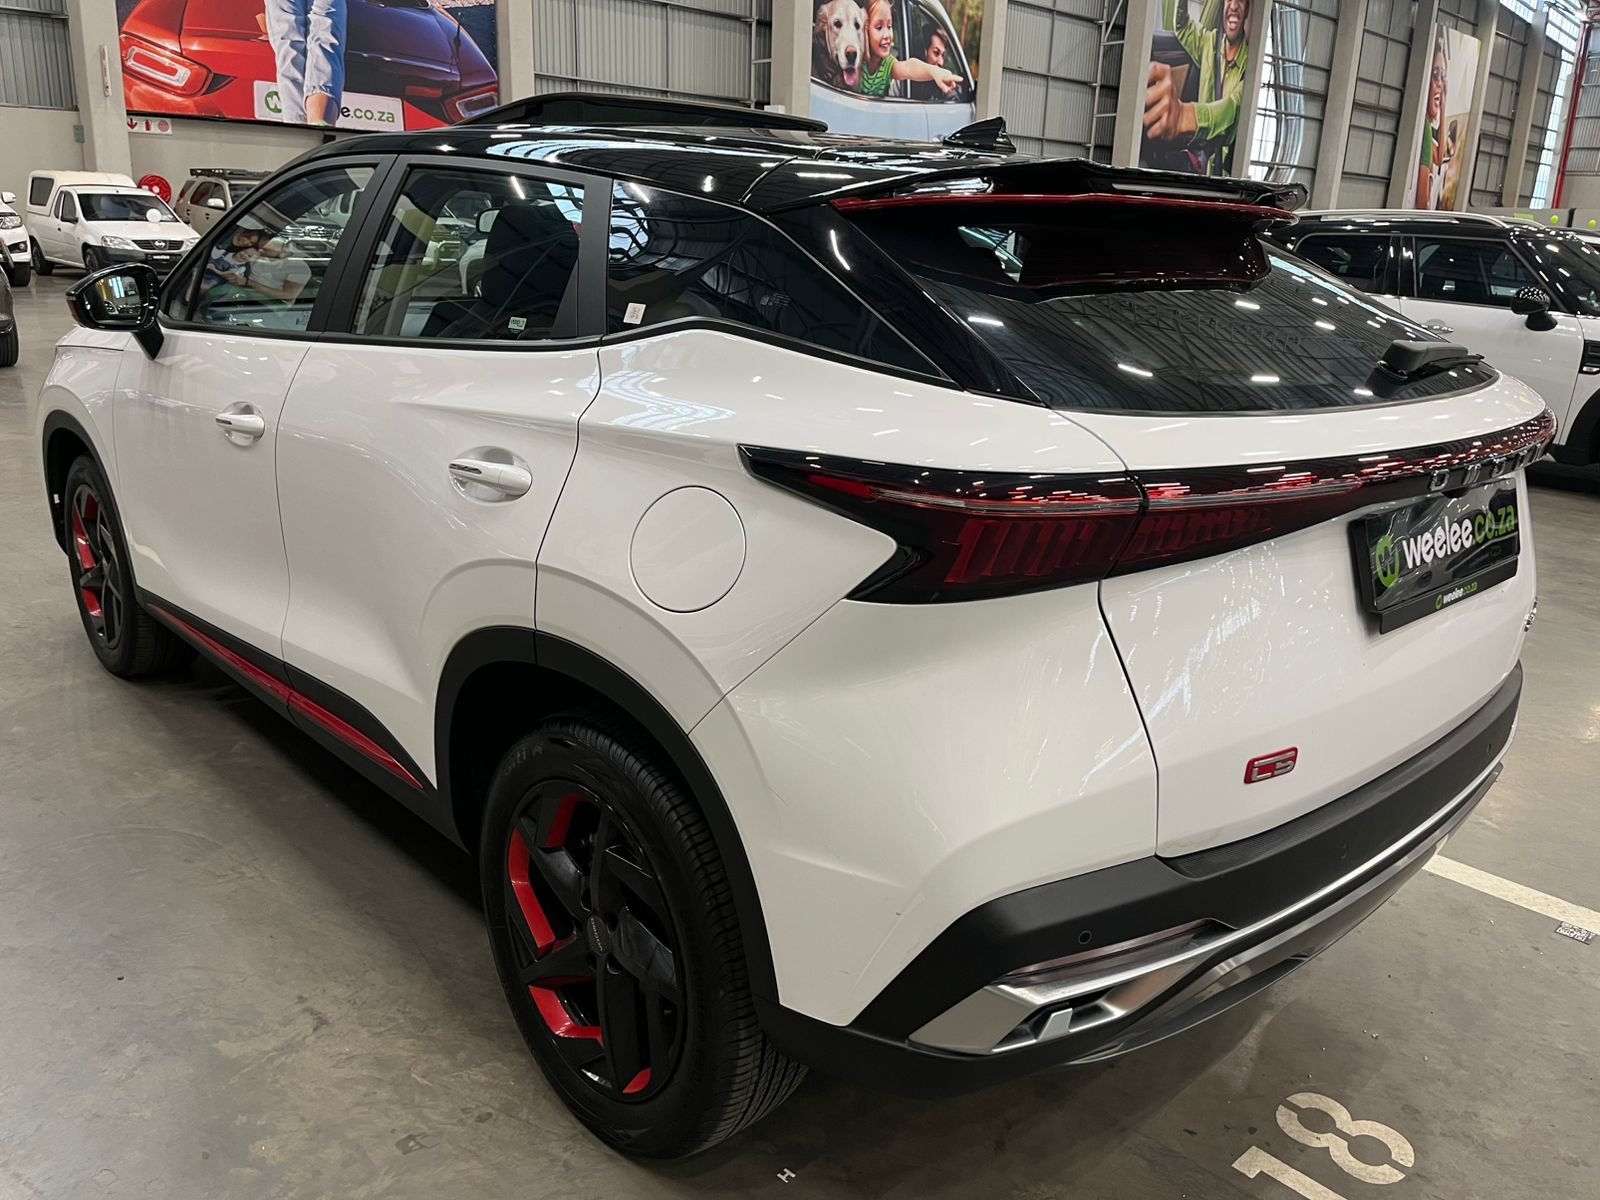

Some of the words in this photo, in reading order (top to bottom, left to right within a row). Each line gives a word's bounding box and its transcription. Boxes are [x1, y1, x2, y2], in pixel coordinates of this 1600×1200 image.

[340, 106, 396, 123] e.co.za
[1402, 505, 1515, 569] weelee.co.za
[1231, 1092, 1415, 1200] 18
